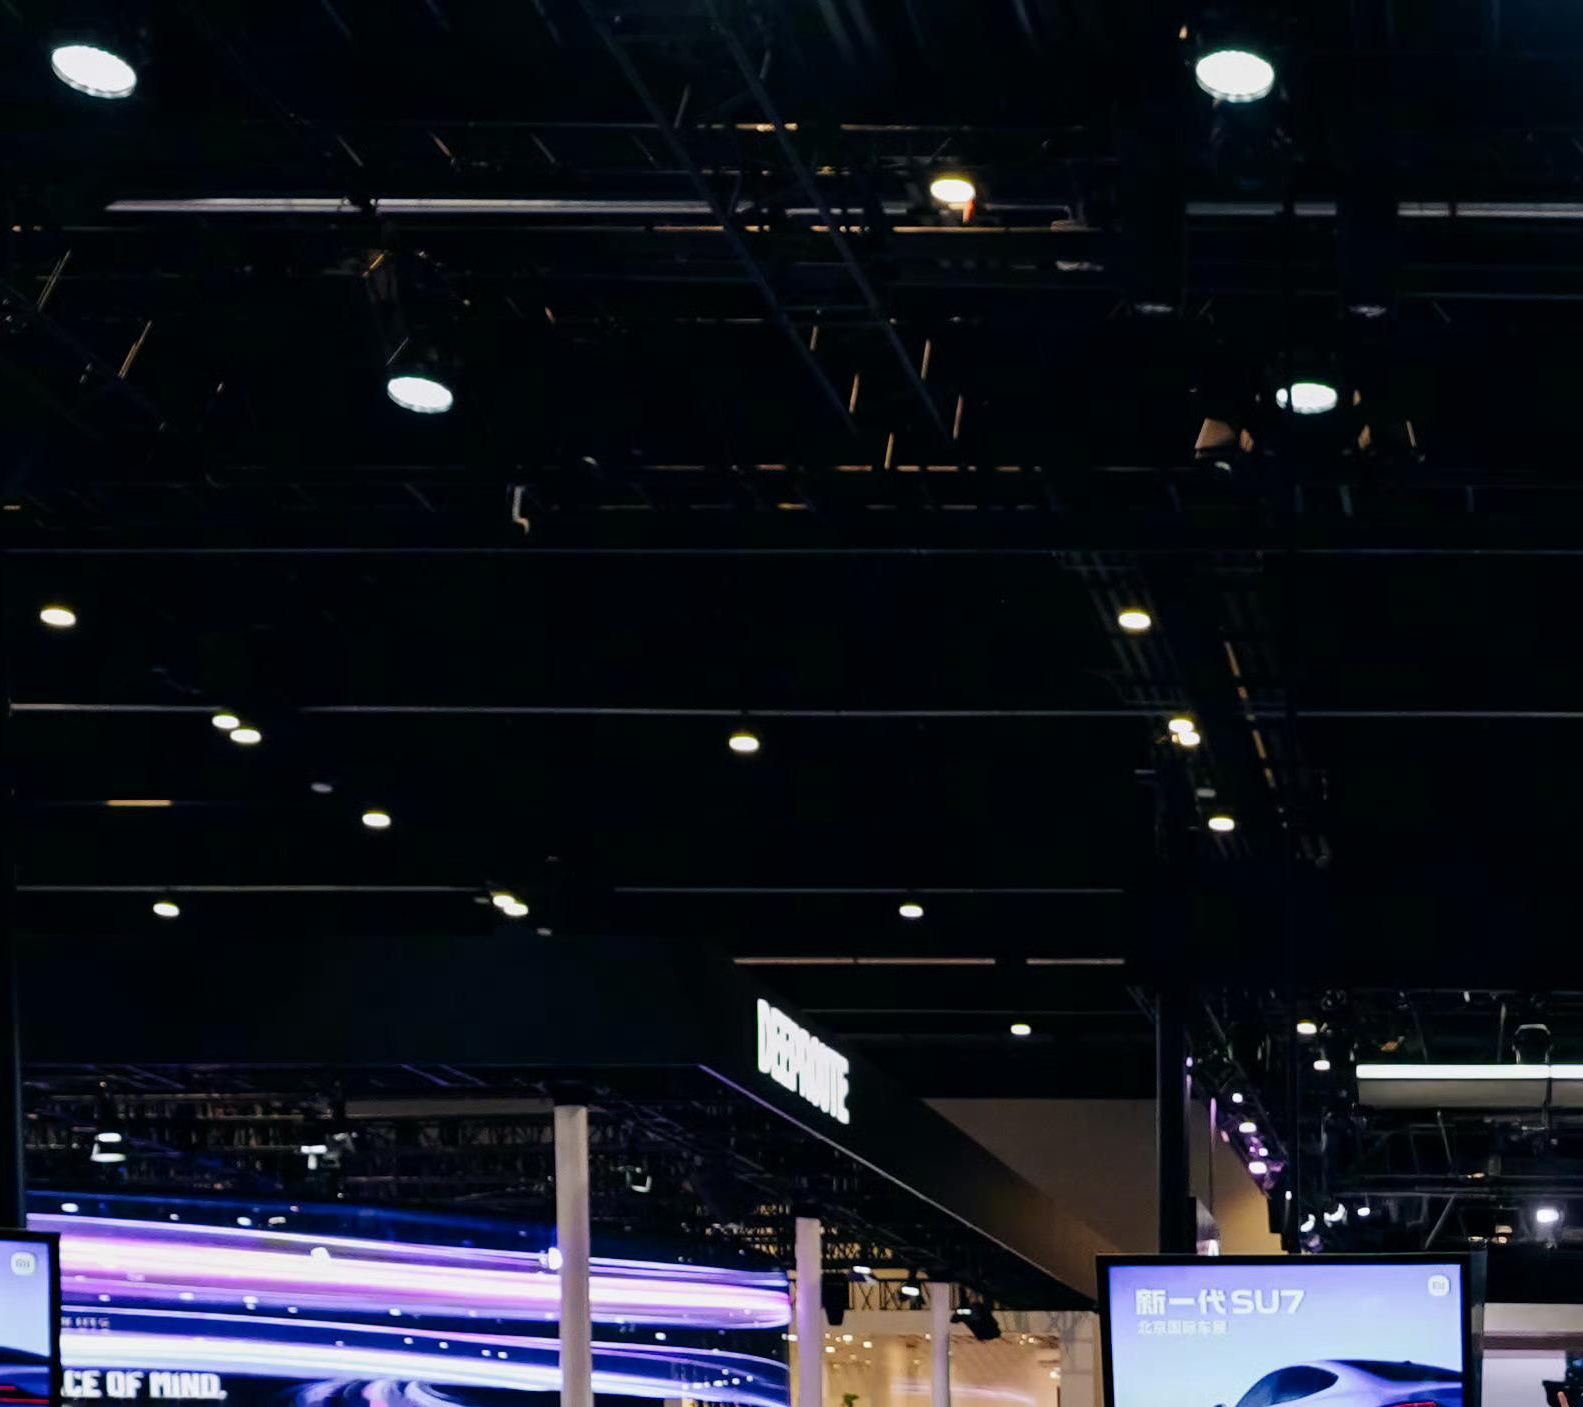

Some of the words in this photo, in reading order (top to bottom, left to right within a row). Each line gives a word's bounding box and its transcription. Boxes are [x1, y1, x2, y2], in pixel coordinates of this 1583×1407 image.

[757, 998, 850, 1125] DEEPROUTE
[1135, 1288, 1306, 1316] 新一代SU7
[61, 1369, 102, 1399] CE
[106, 1370, 145, 1399] OF
